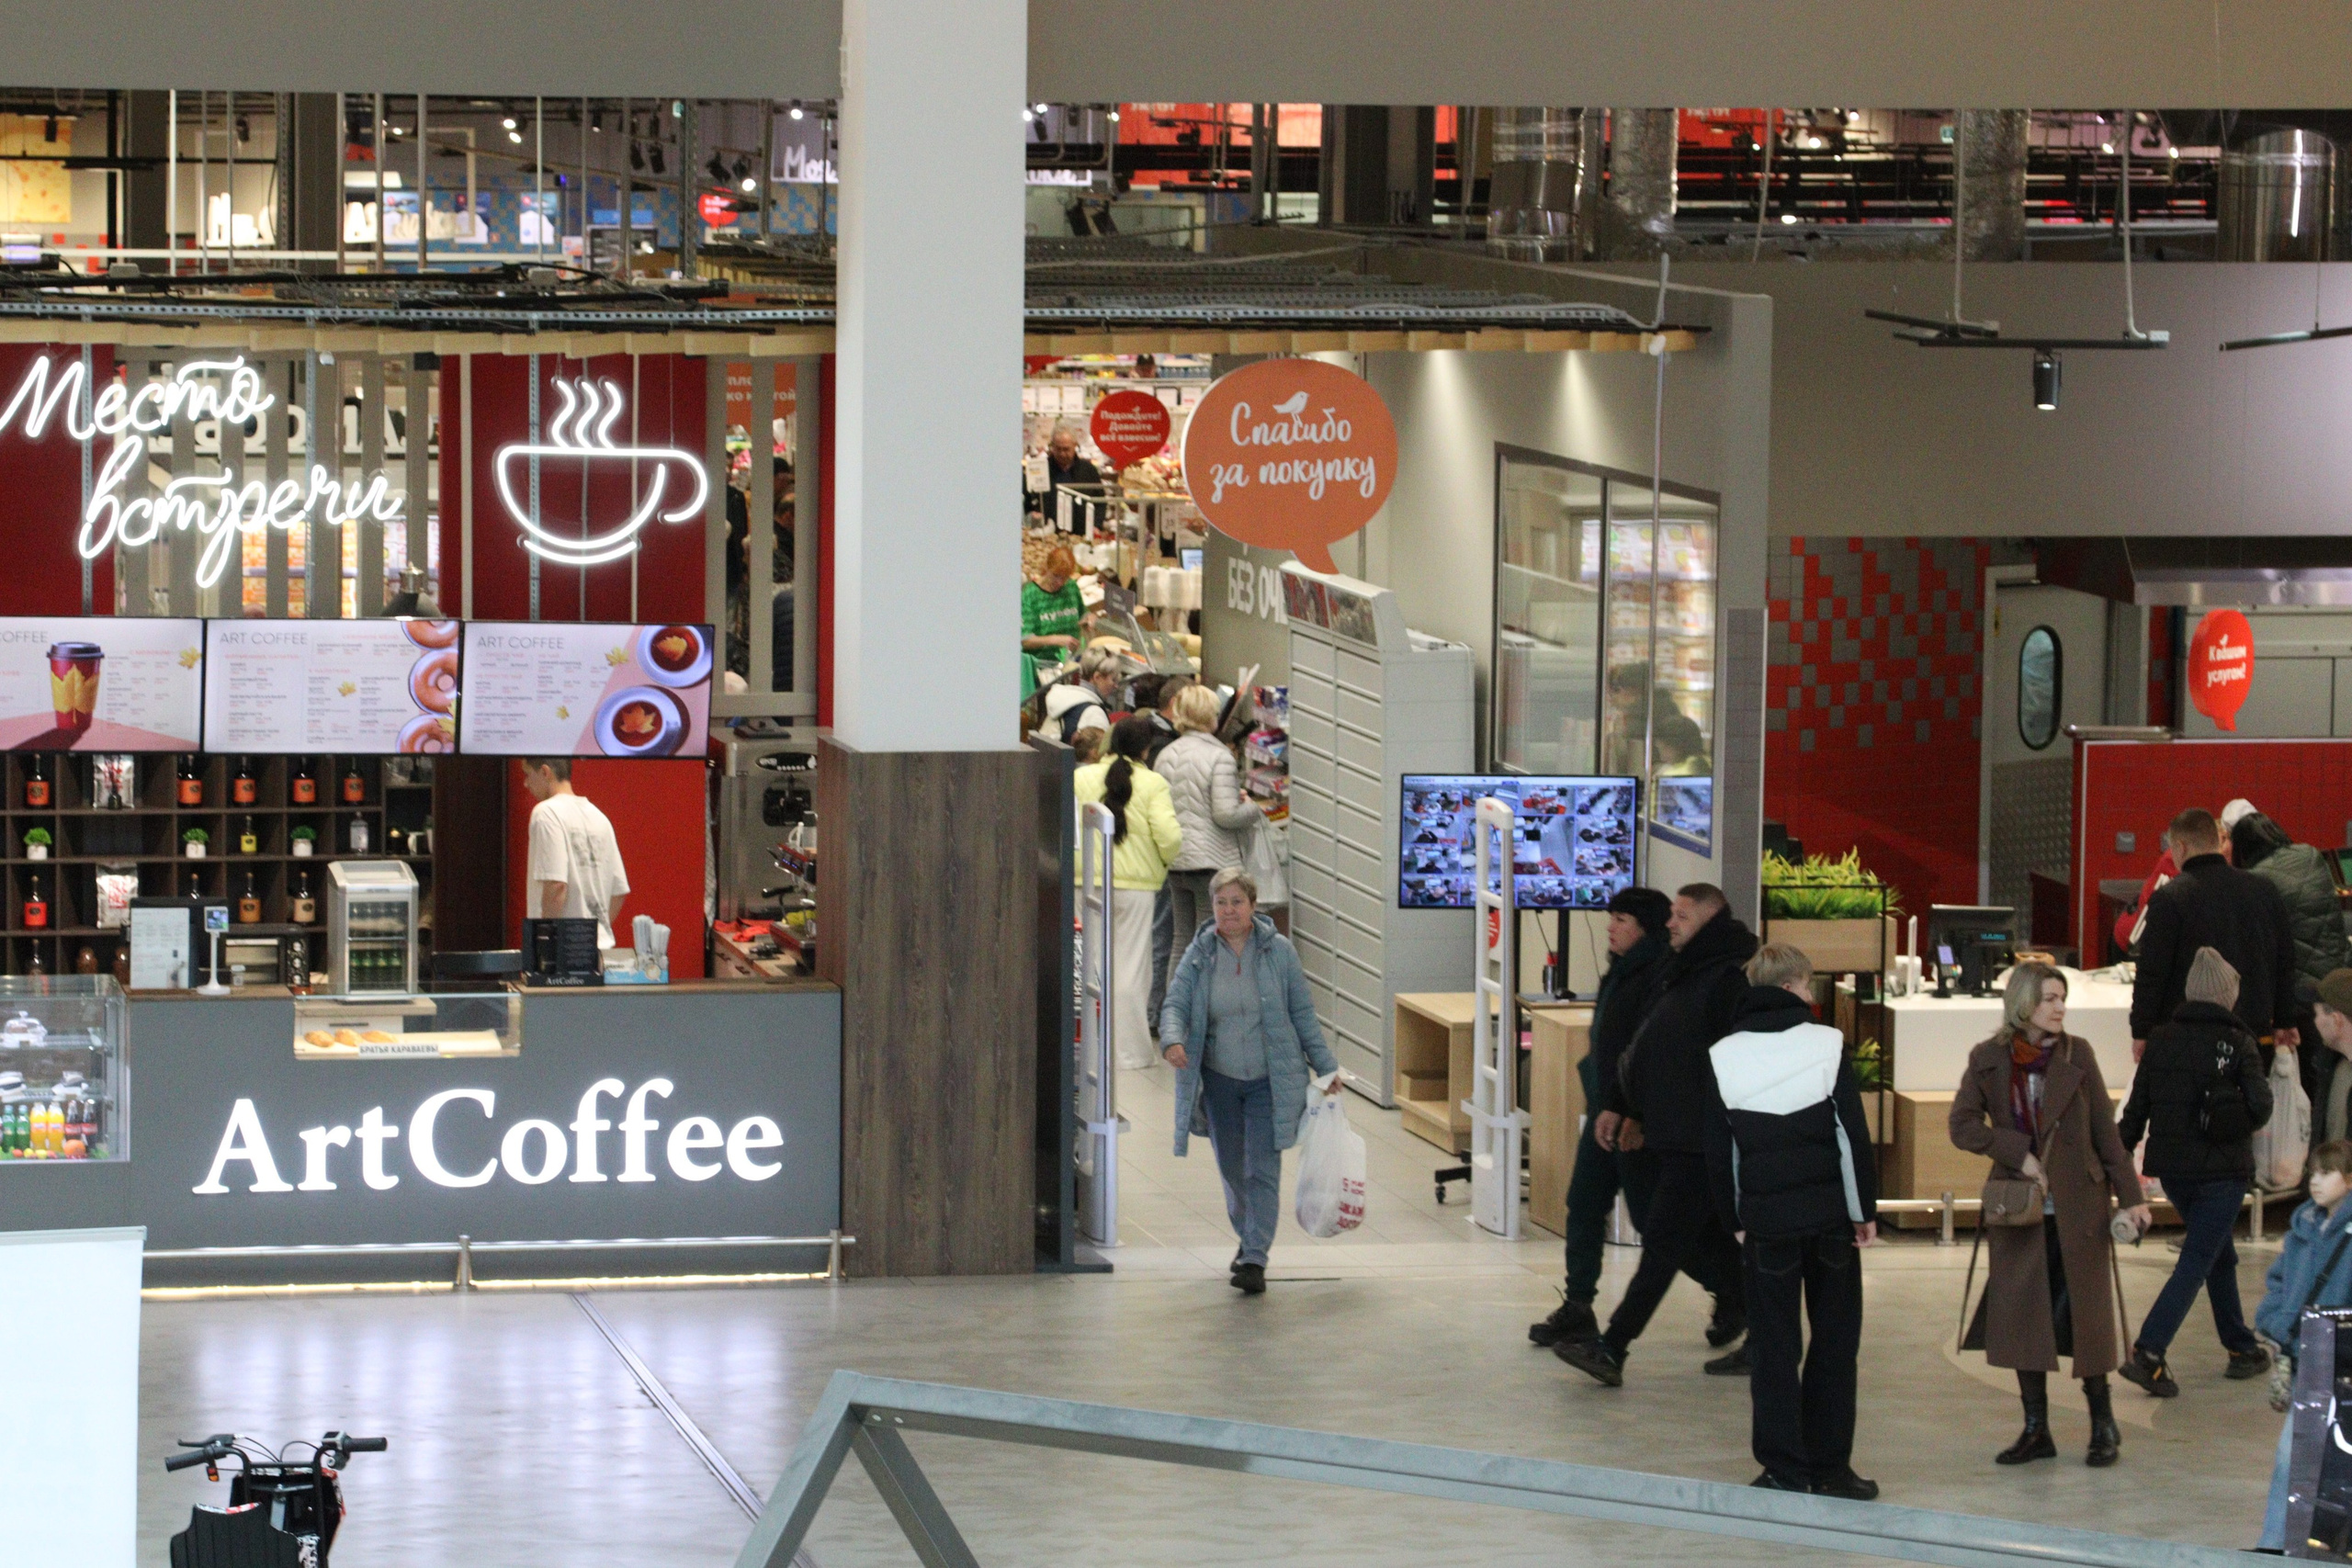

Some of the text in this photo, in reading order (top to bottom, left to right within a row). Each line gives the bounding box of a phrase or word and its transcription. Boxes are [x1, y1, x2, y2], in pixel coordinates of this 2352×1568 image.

[0, 355, 275, 439] Место
[1230, 401, 1351, 446] Спасибо
[1210, 457, 1376, 504] за покупку
[78, 434, 403, 590] встречи
[1228, 556, 1254, 615] БЕЗ
[0, 630, 49, 644] OFFEE
[220, 632, 309, 645] ART COFFEE
[478, 636, 565, 649] ART COFFEE
[360, 1045, 389, 1054] БРАТЬЯ
[192, 1077, 785, 1194] ArtCoffee
